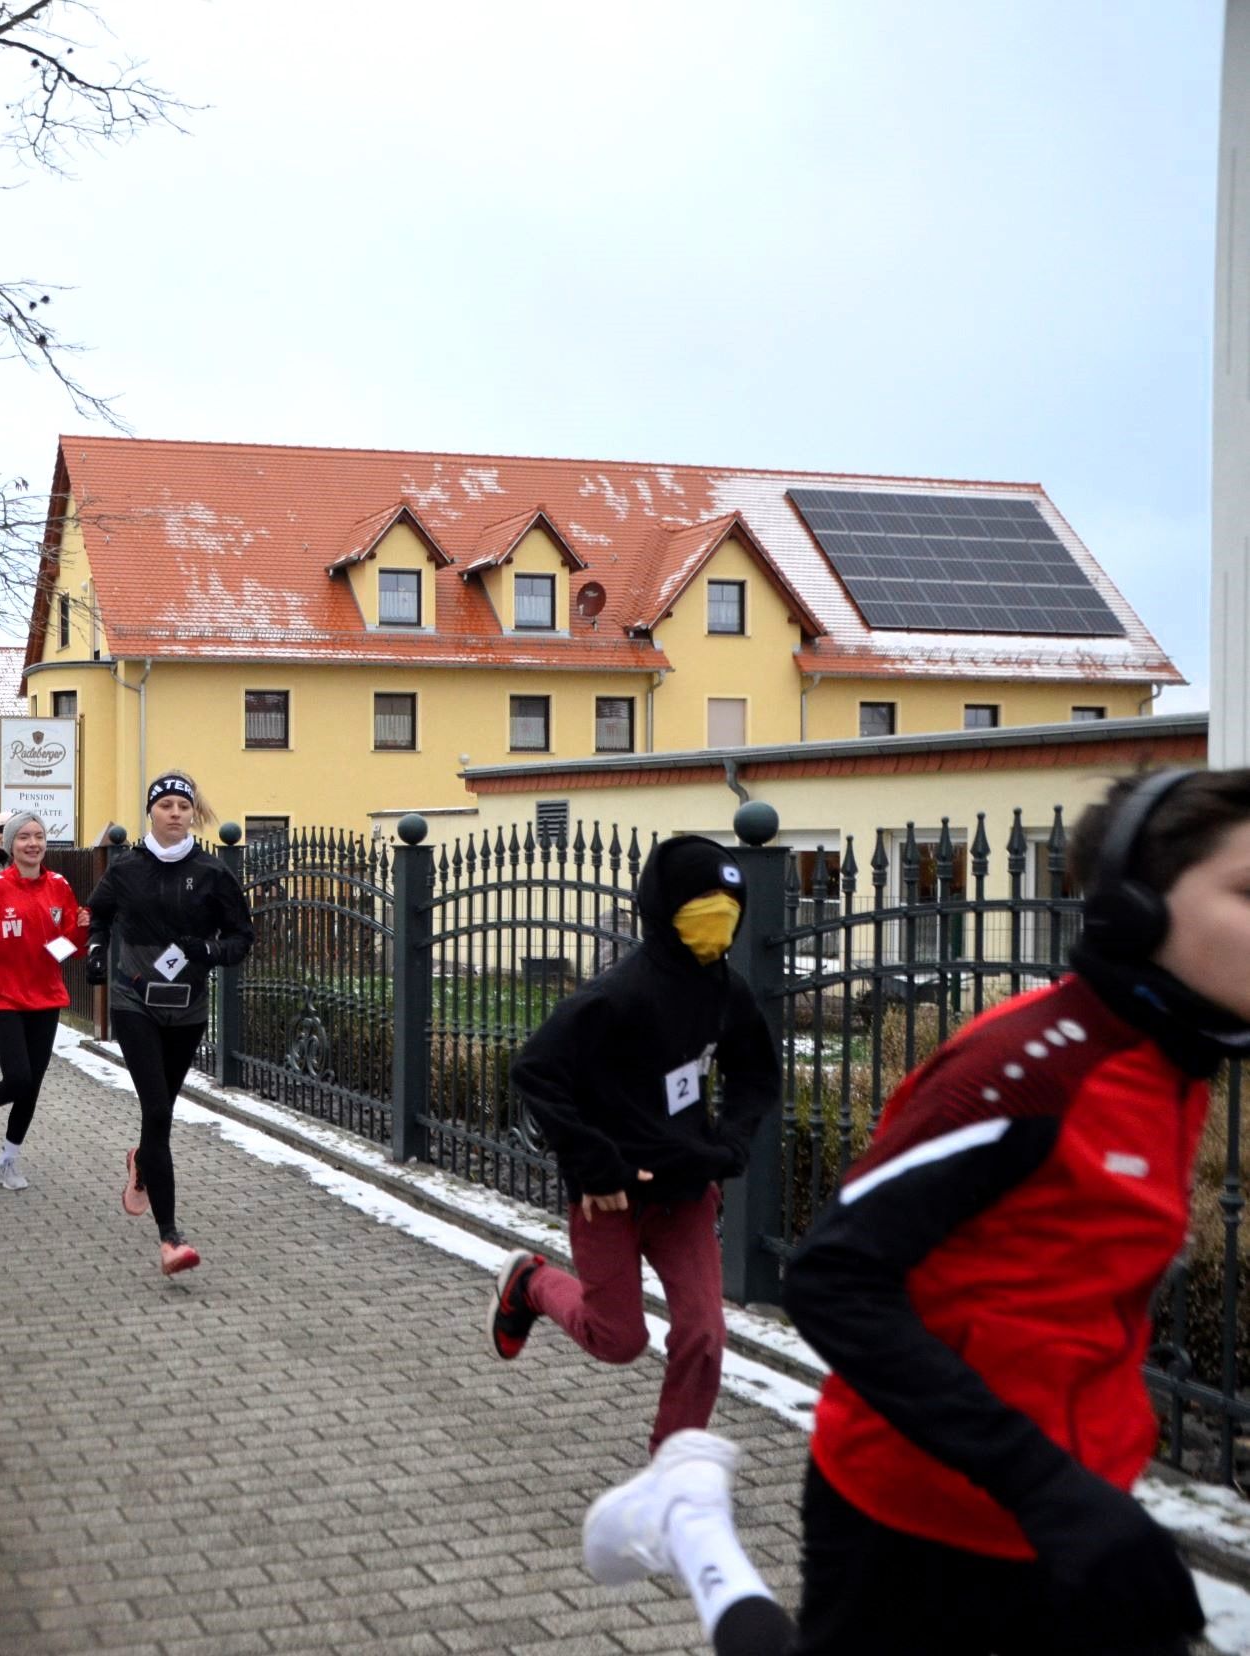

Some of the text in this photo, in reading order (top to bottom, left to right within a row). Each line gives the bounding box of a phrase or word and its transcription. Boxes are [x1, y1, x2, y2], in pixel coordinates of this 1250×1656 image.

[10, 740, 64, 763] Radeberger
[1, 919, 23, 939] PV
[165, 958, 179, 970] 4
[676, 1077, 690, 1100] 2
